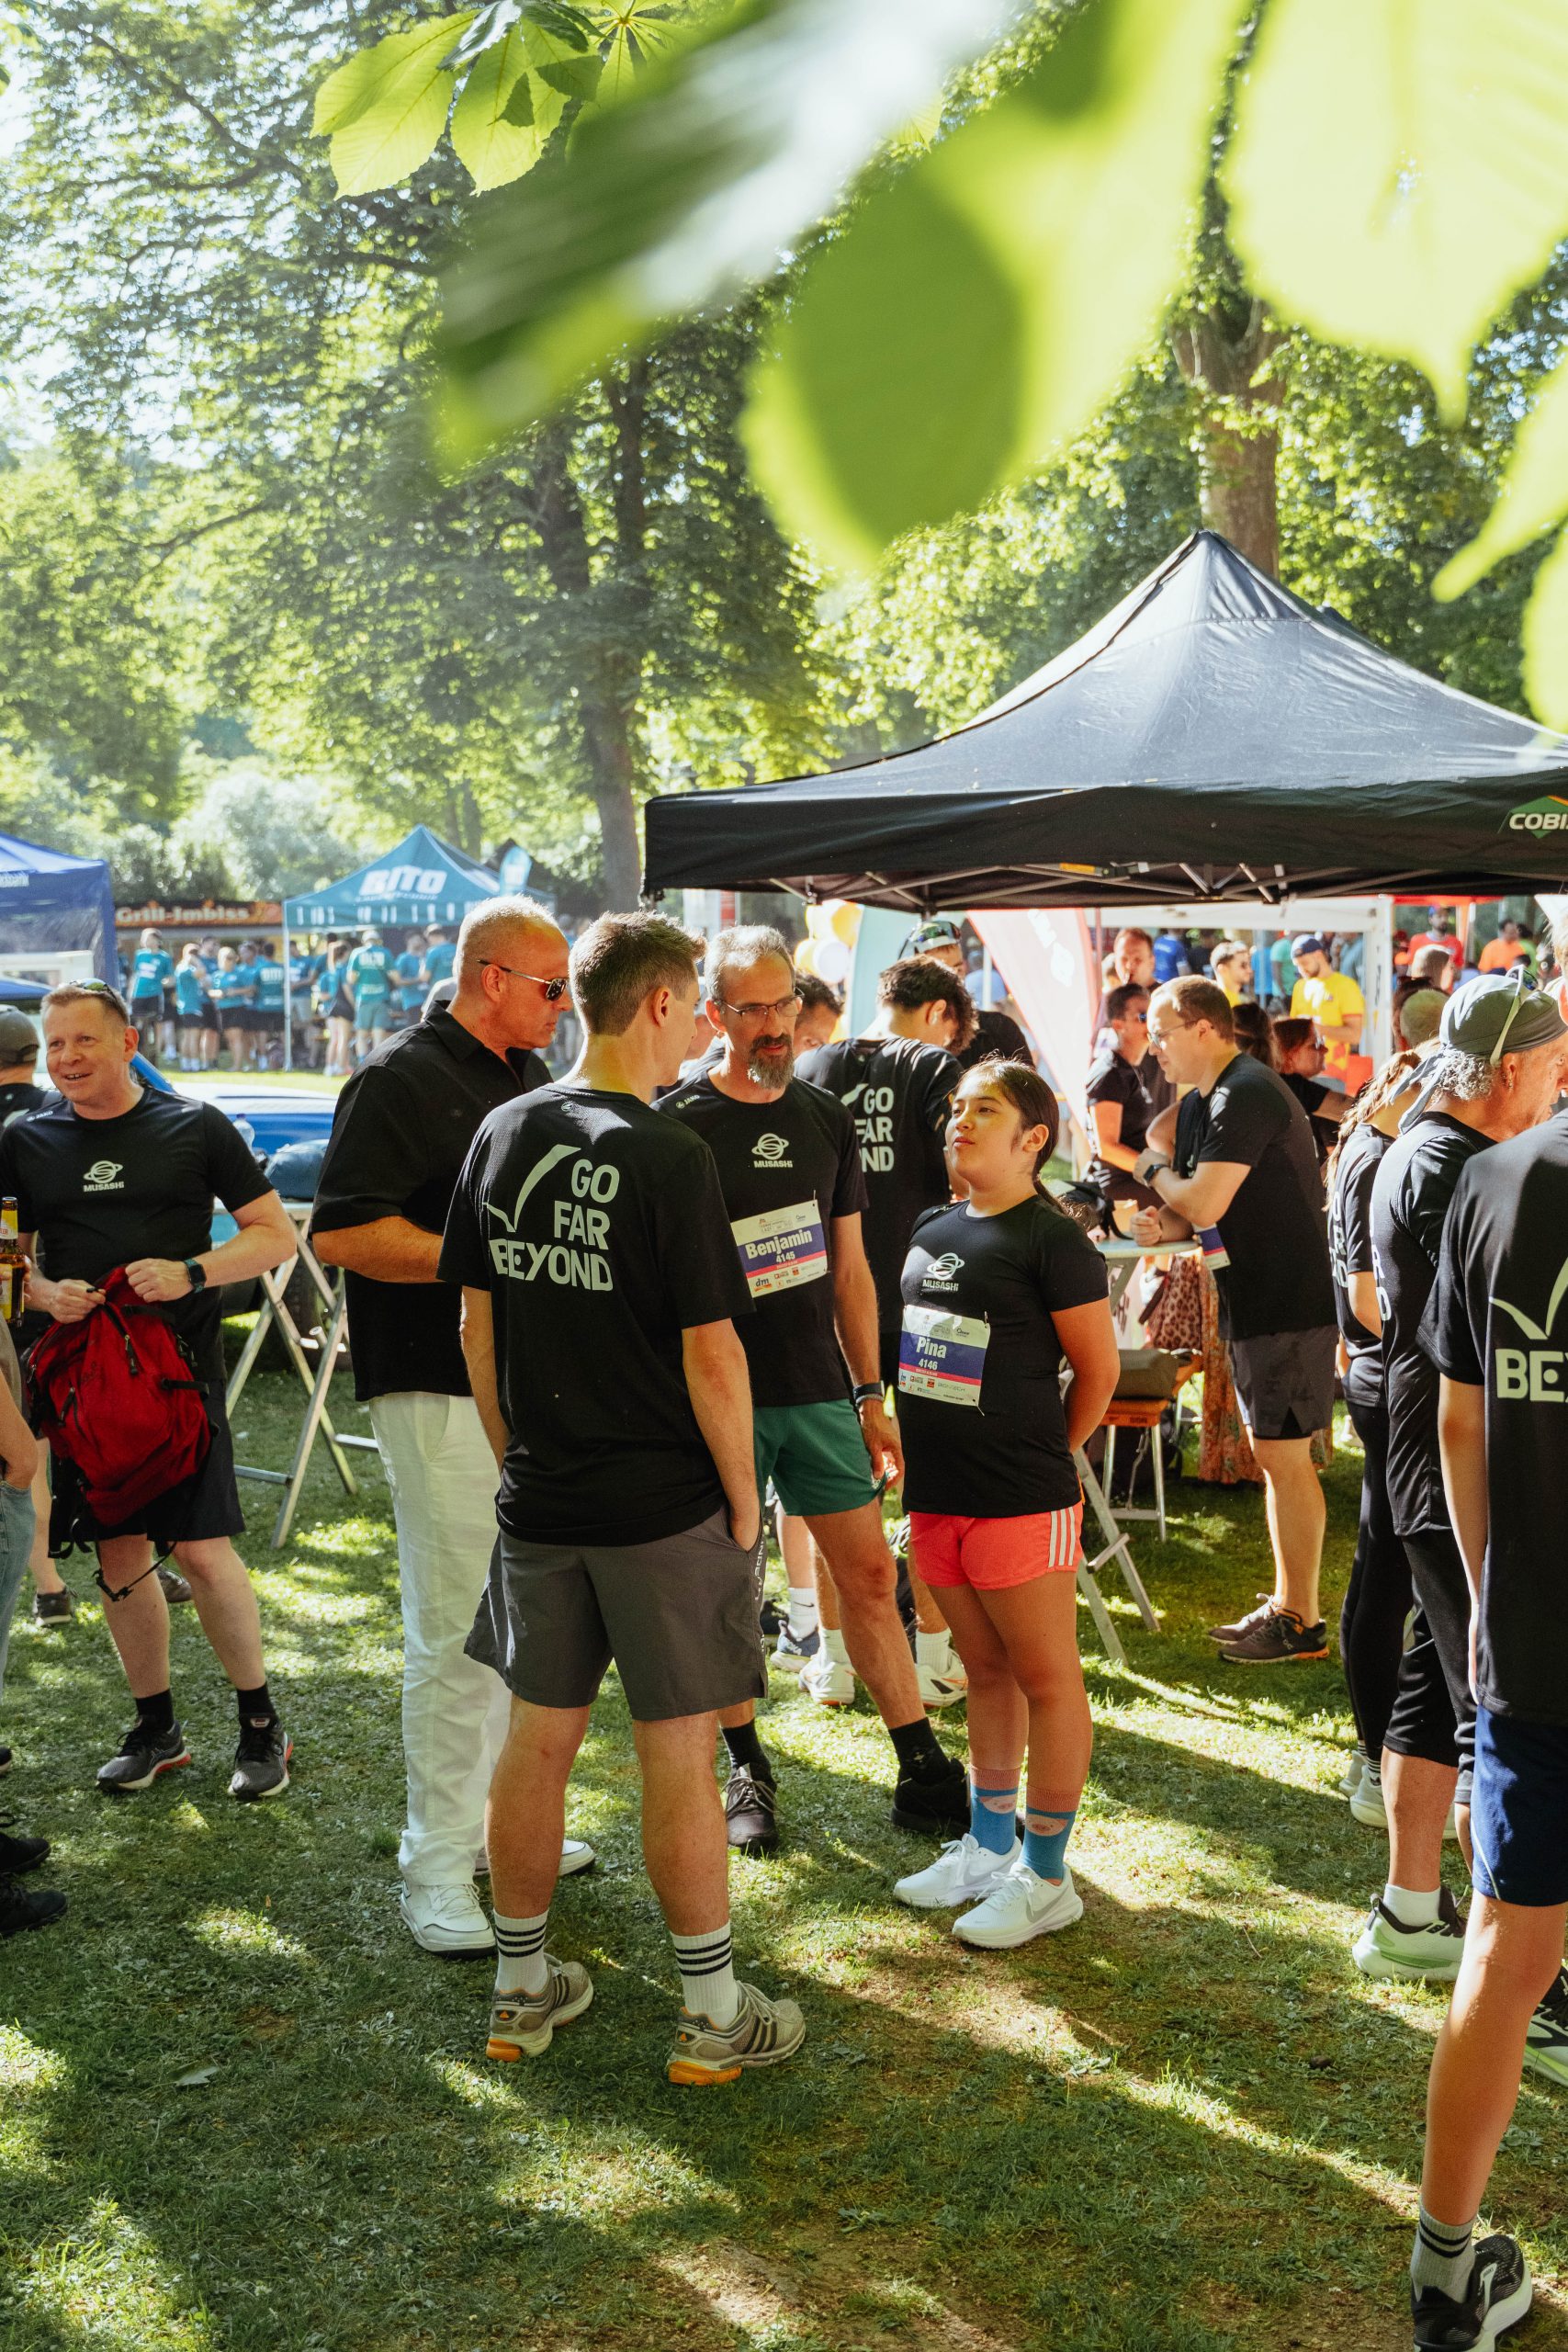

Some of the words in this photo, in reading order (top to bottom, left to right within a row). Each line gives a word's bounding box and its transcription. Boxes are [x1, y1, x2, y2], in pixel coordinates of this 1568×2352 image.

[1509, 813, 1568, 830] COBI
[358, 865, 447, 895] BITO
[116, 905, 250, 922] Grill-Imbiss
[684, 1094, 700, 1105] JAKO
[863, 1086, 895, 1114] GO
[854, 1116, 894, 1144] FAR
[571, 1159, 620, 1204] GO
[553, 1200, 611, 1250] FAR
[745, 1229, 813, 1260] Benjamin
[775, 1250, 795, 1263] 4145
[489, 1238, 614, 1292] BEYOND
[755, 1277, 770, 1287] dm
[916, 1336, 947, 1359] Pina
[919, 1358, 938, 1371] 4146
[1495, 1348, 1568, 1403] BE
